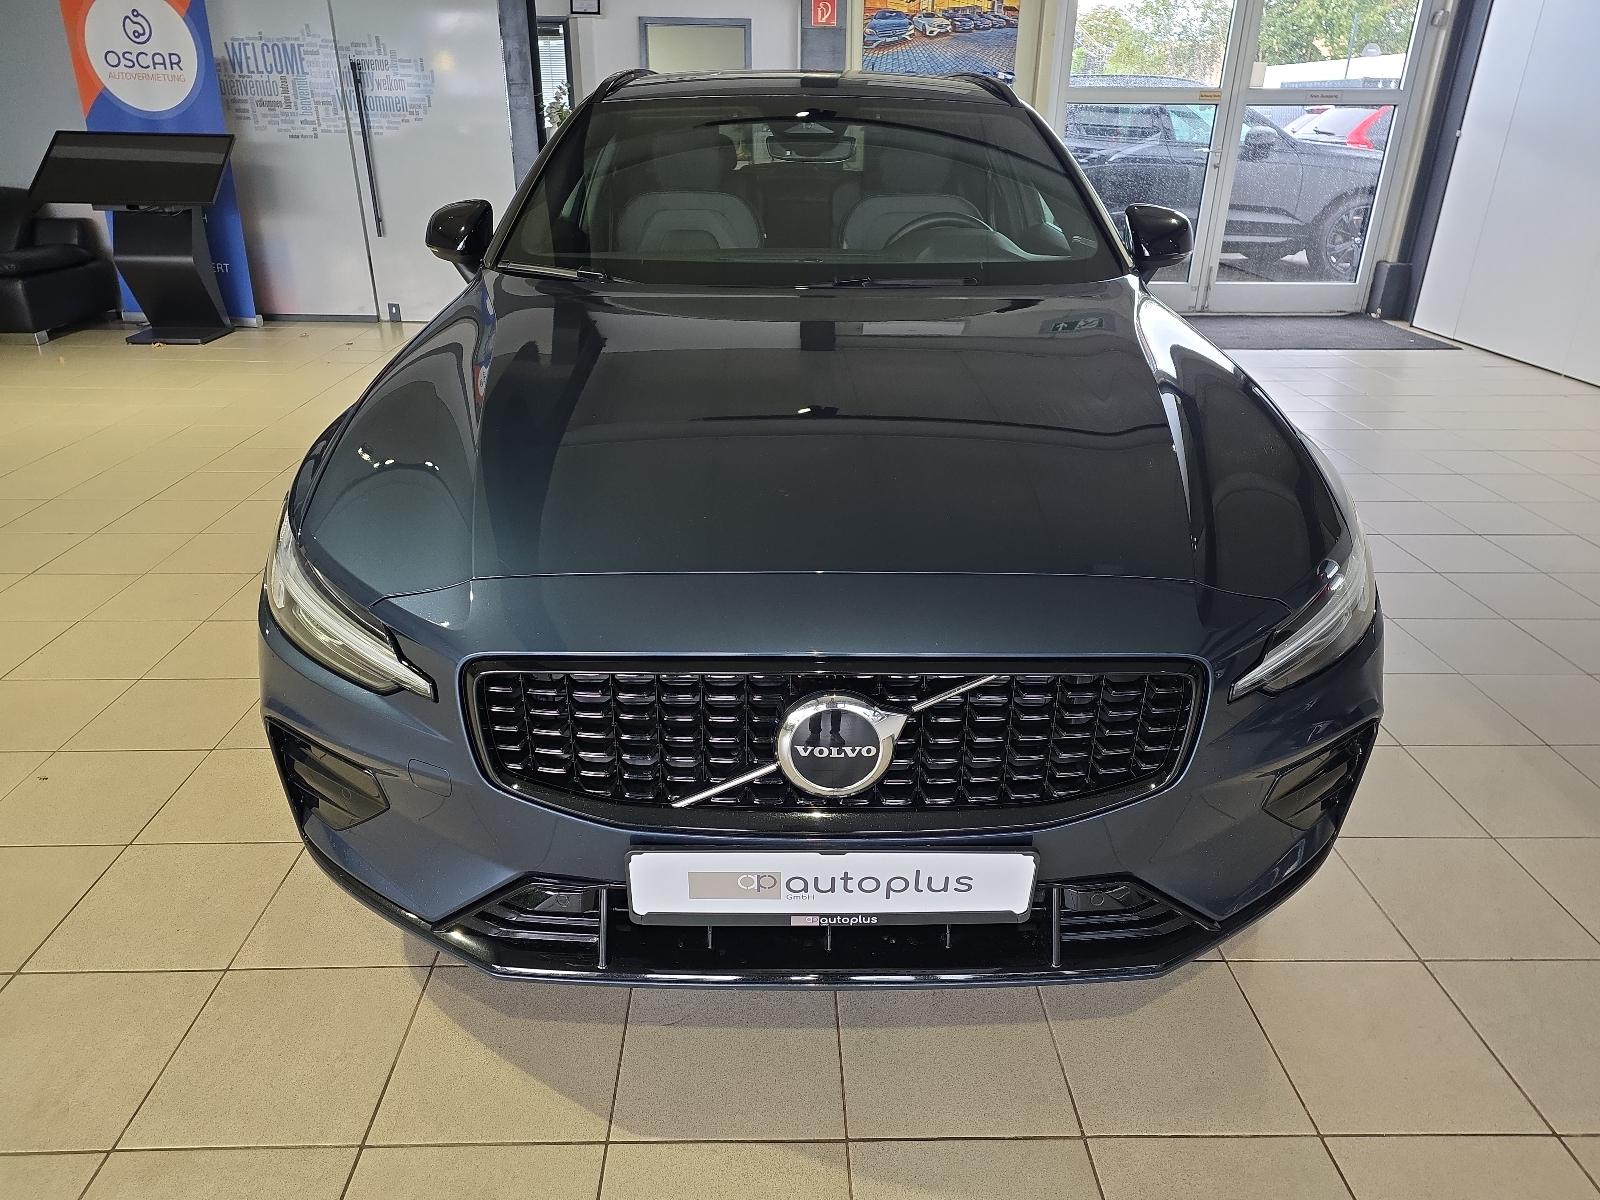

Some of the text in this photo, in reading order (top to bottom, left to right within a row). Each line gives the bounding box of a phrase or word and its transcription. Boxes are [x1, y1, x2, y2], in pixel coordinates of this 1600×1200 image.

[104, 50, 183, 71] OSCAR
[224, 41, 309, 76] WELCOME
[108, 71, 186, 83] AUTOVERMIETUNG
[375, 75, 406, 92] welkom
[336, 88, 408, 113] Wikommen
[794, 745, 877, 758] VOLVO
[785, 869, 974, 900] autoplus
[820, 915, 878, 926] autoplus
